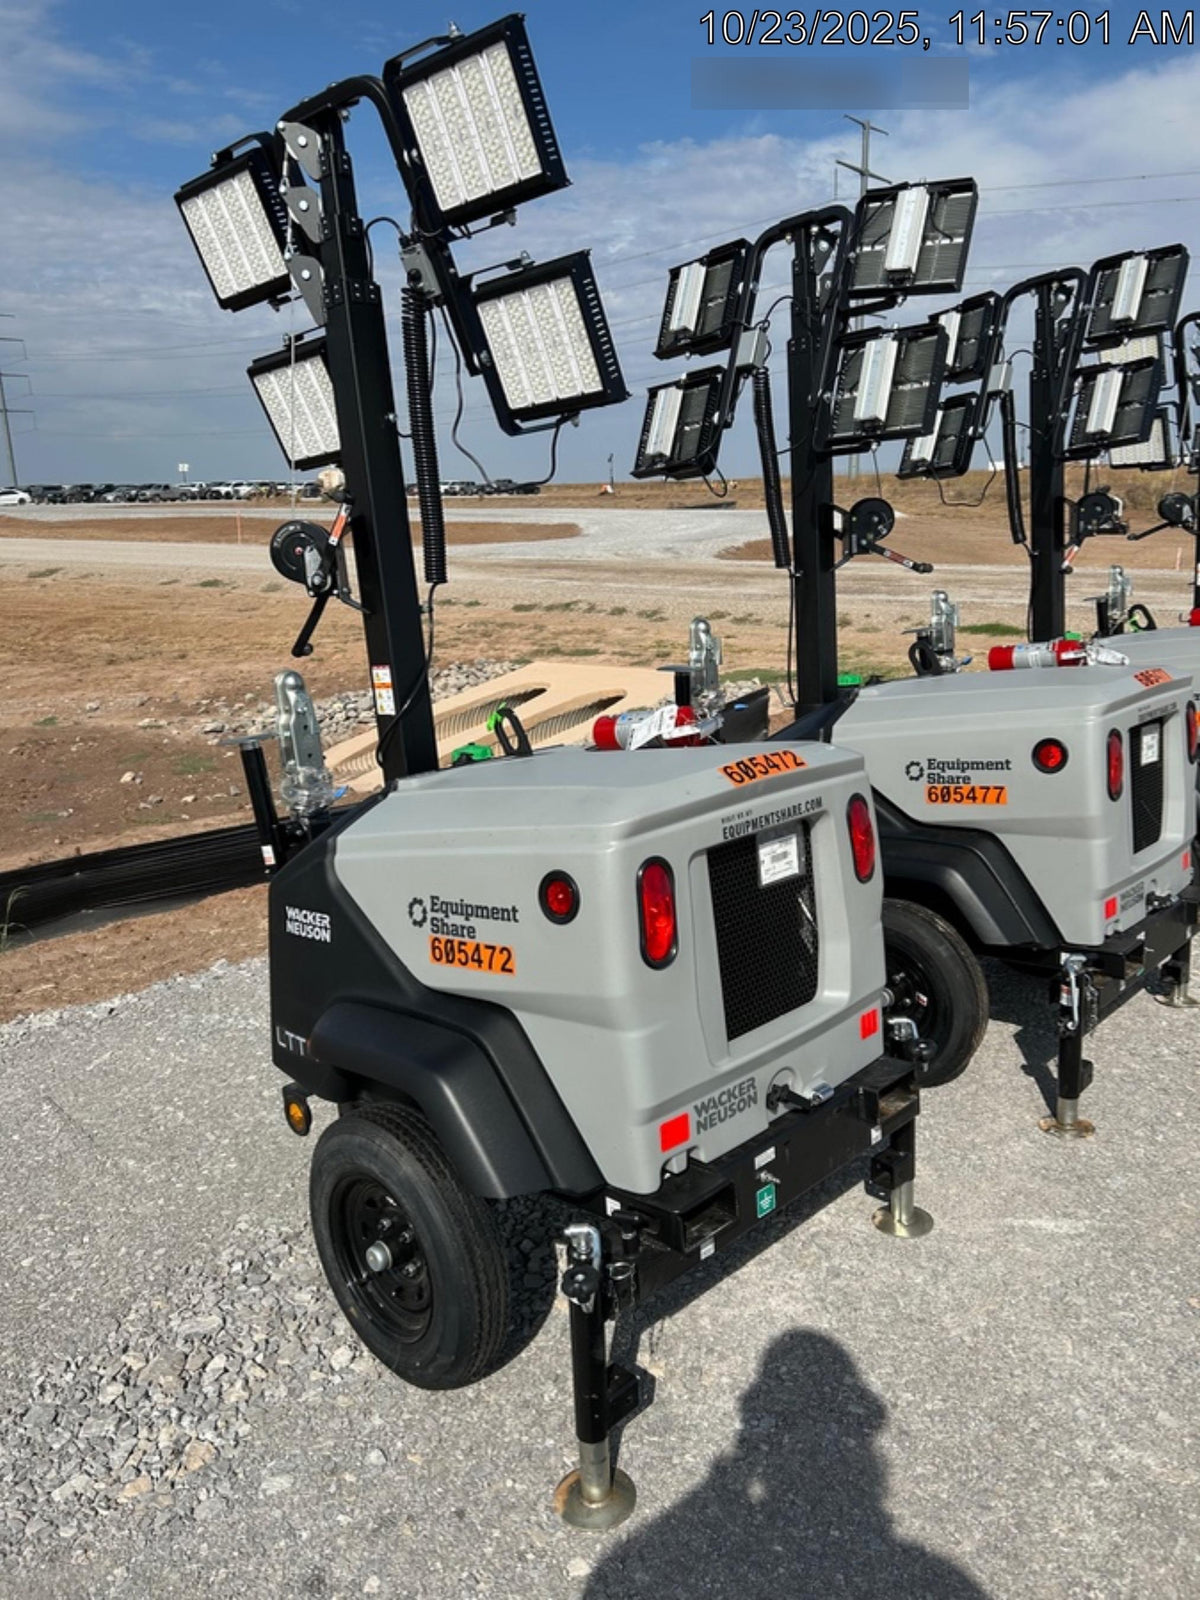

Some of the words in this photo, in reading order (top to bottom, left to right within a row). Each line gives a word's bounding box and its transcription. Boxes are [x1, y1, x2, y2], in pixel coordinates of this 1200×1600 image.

[723, 750, 806, 784] 605472
[927, 758, 1012, 774] Equipment
[927, 773, 972, 785] Share
[927, 785, 1006, 804] 605477
[722, 796, 823, 840] EQUIPMENTSHARE.COM
[285, 905, 331, 929] WACKER
[430, 895, 520, 923] Equipment
[285, 920, 332, 943] NEUSON
[430, 916, 477, 940] Share
[430, 936, 514, 974] 605472
[693, 1076, 758, 1120] WACKER
[696, 1091, 759, 1136] NEUSON
